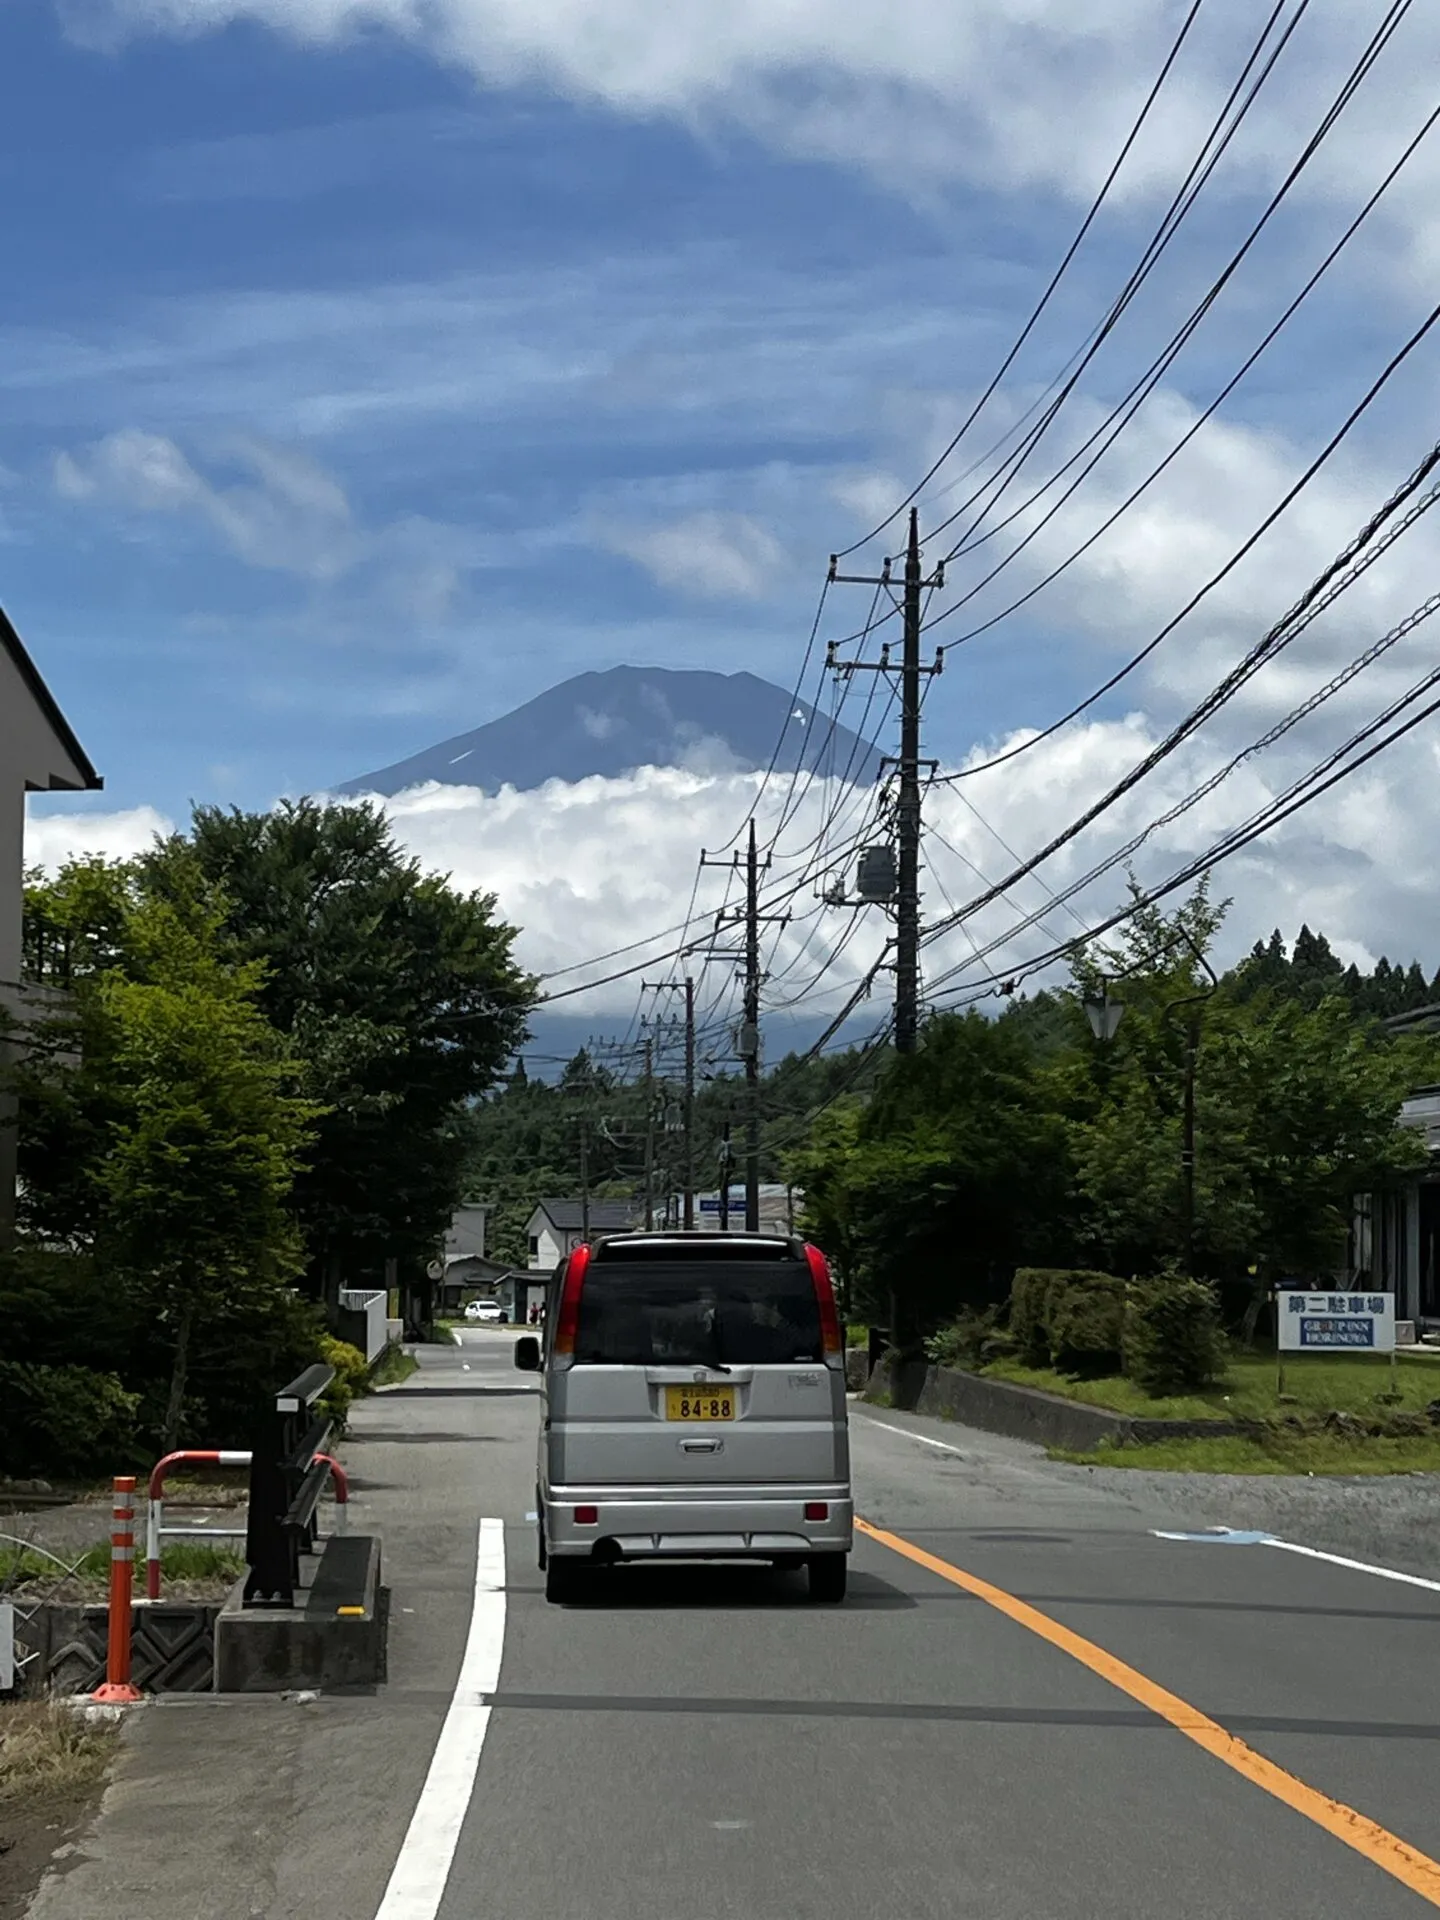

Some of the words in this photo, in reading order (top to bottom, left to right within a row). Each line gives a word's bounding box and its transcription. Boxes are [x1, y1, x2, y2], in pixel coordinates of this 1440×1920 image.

[1288, 1296, 1385, 1314] 第二駐車場
[681, 1400, 731, 1417] 84-88
